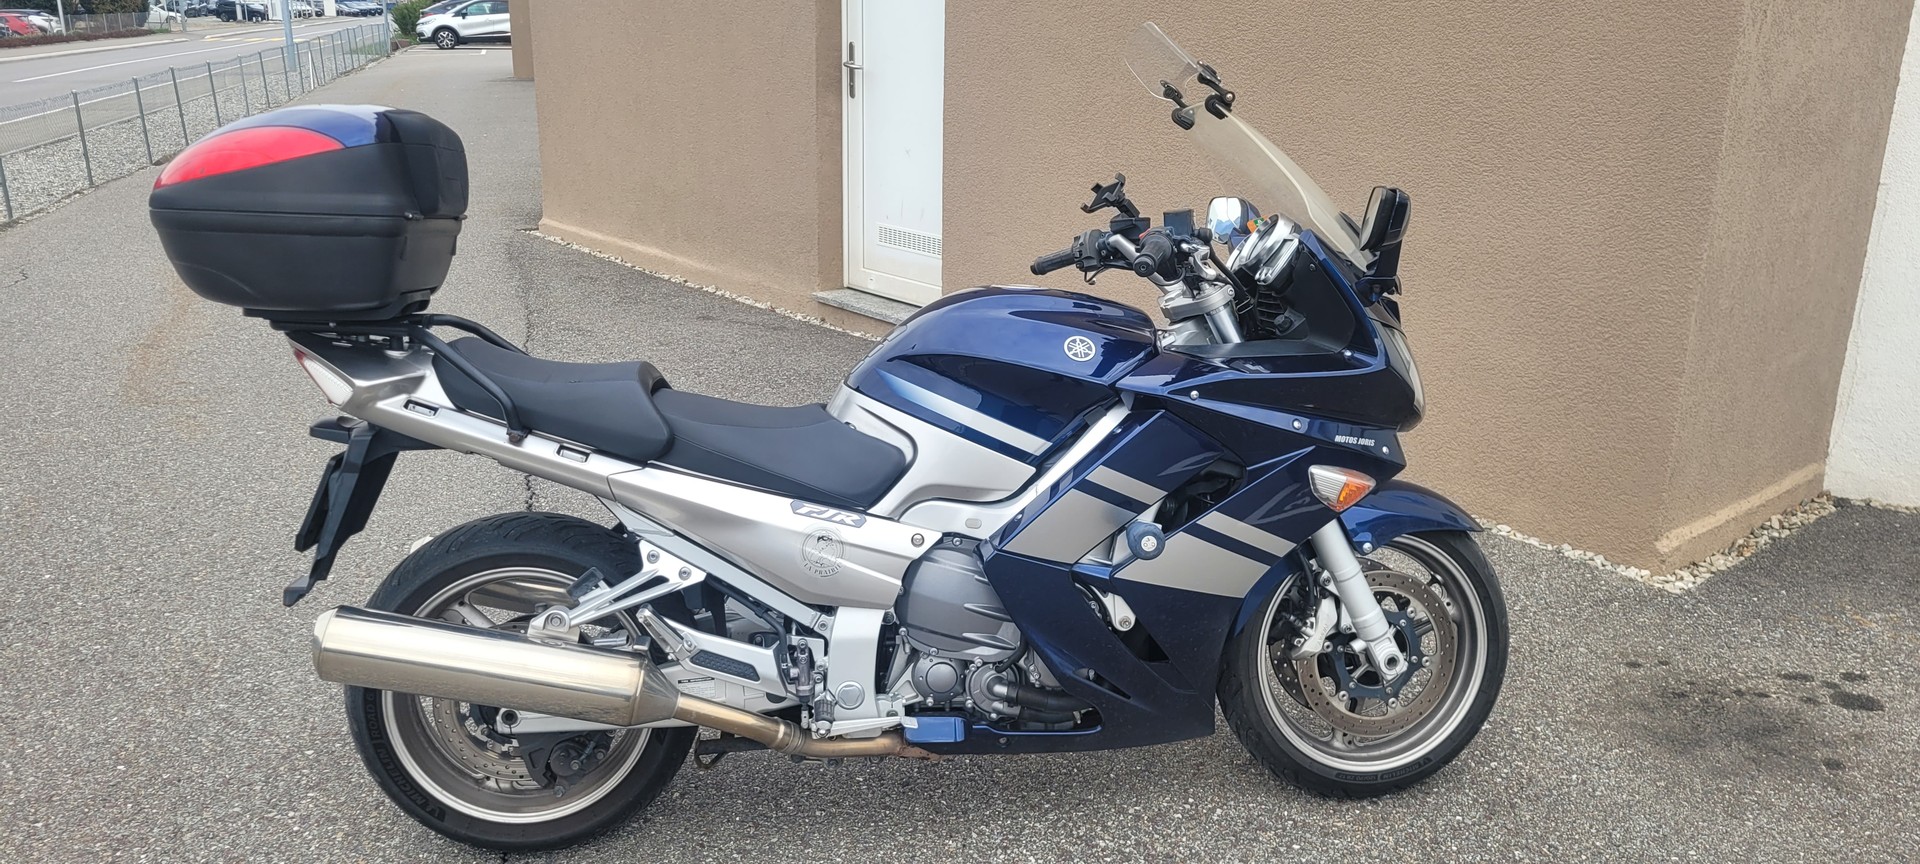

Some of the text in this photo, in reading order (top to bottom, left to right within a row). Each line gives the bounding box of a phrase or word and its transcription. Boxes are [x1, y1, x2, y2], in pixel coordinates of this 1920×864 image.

[1334, 435, 1375, 447] MOTOS JORIS
[794, 503, 861, 526] FJR
[367, 703, 381, 738] ROAD
[377, 747, 427, 805] MICHELIN
[1383, 763, 1419, 780] MICHELIN
